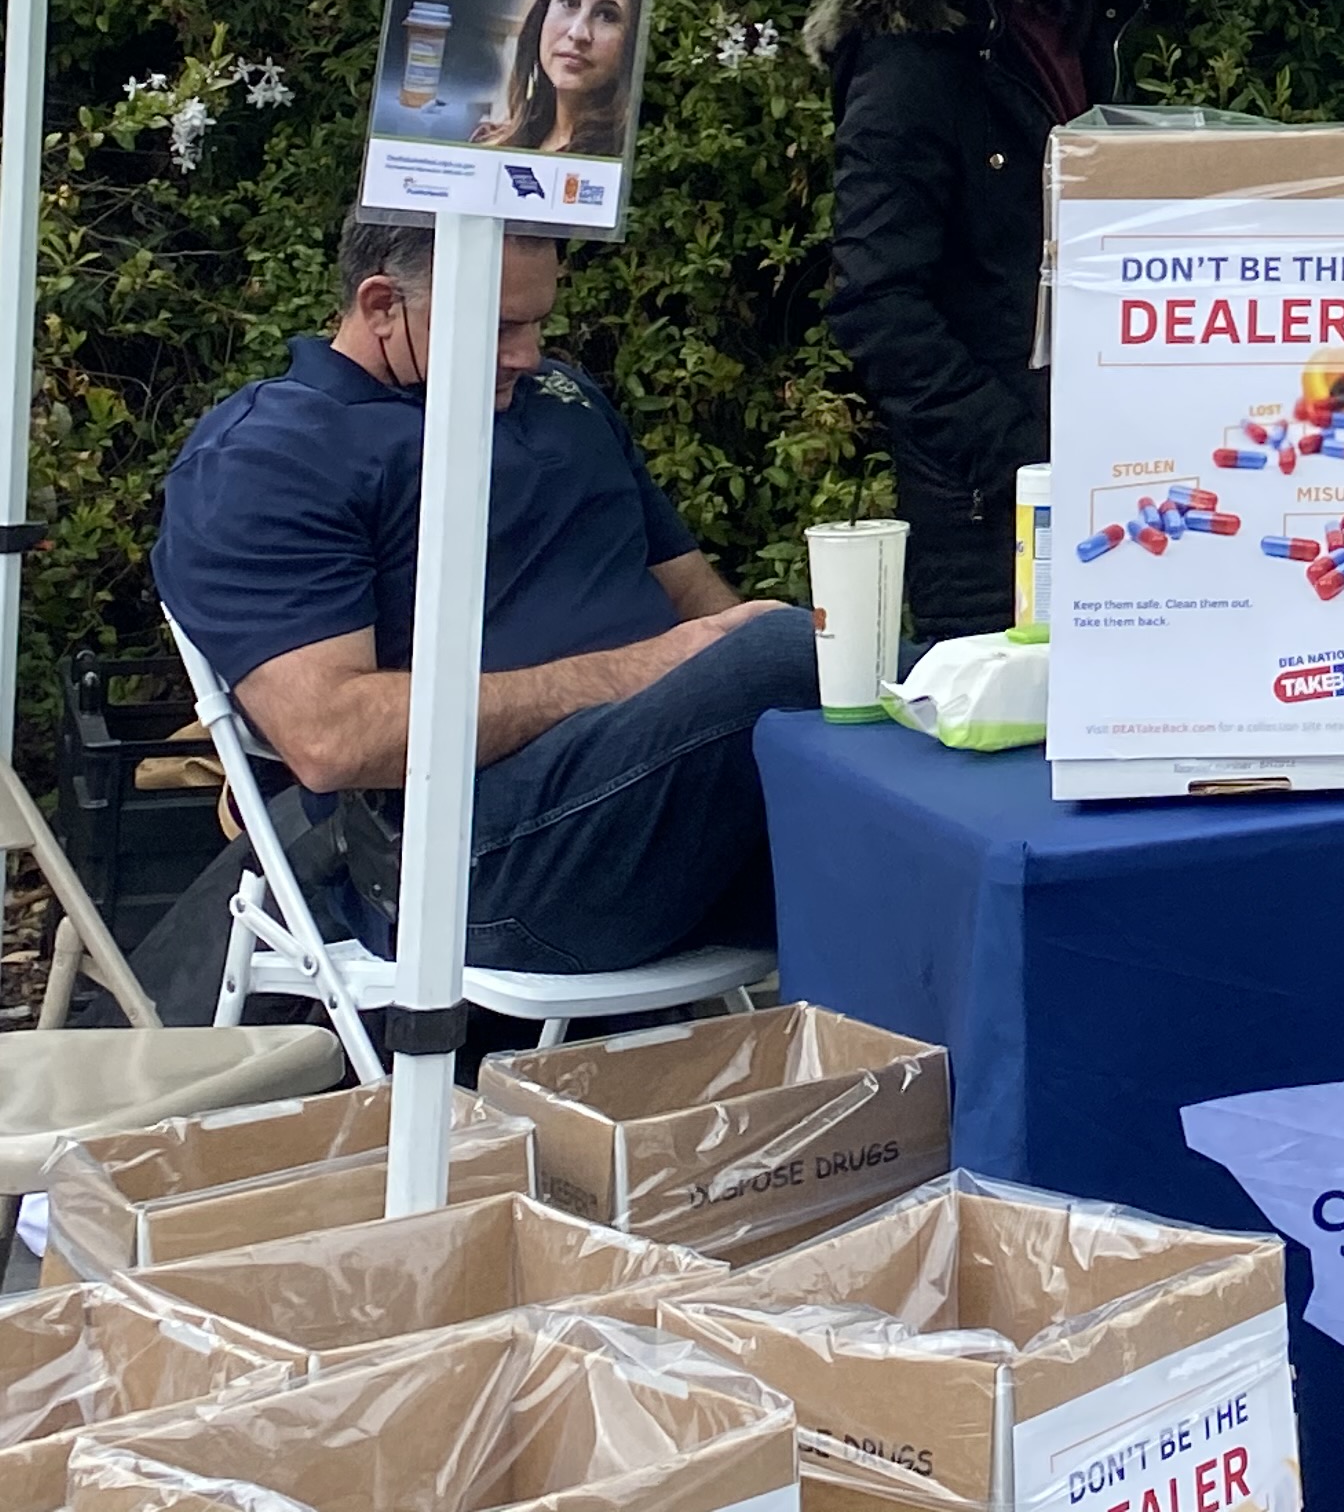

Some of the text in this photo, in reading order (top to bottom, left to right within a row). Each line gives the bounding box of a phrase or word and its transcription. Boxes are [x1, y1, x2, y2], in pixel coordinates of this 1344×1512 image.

[1121, 257, 1229, 282] DON'T
[1241, 257, 1280, 282] BE
[1249, 403, 1283, 417] LOST
[1112, 459, 1175, 478] STOLEN
[1073, 599, 1253, 612] Keep them safe. Clean them out.
[1073, 616, 1170, 627] Take them back.
[1279, 656, 1305, 667] DEA
[815, 1140, 900, 1180] DRUGS
[1068, 1393, 1249, 1505] DON'T BE THE
